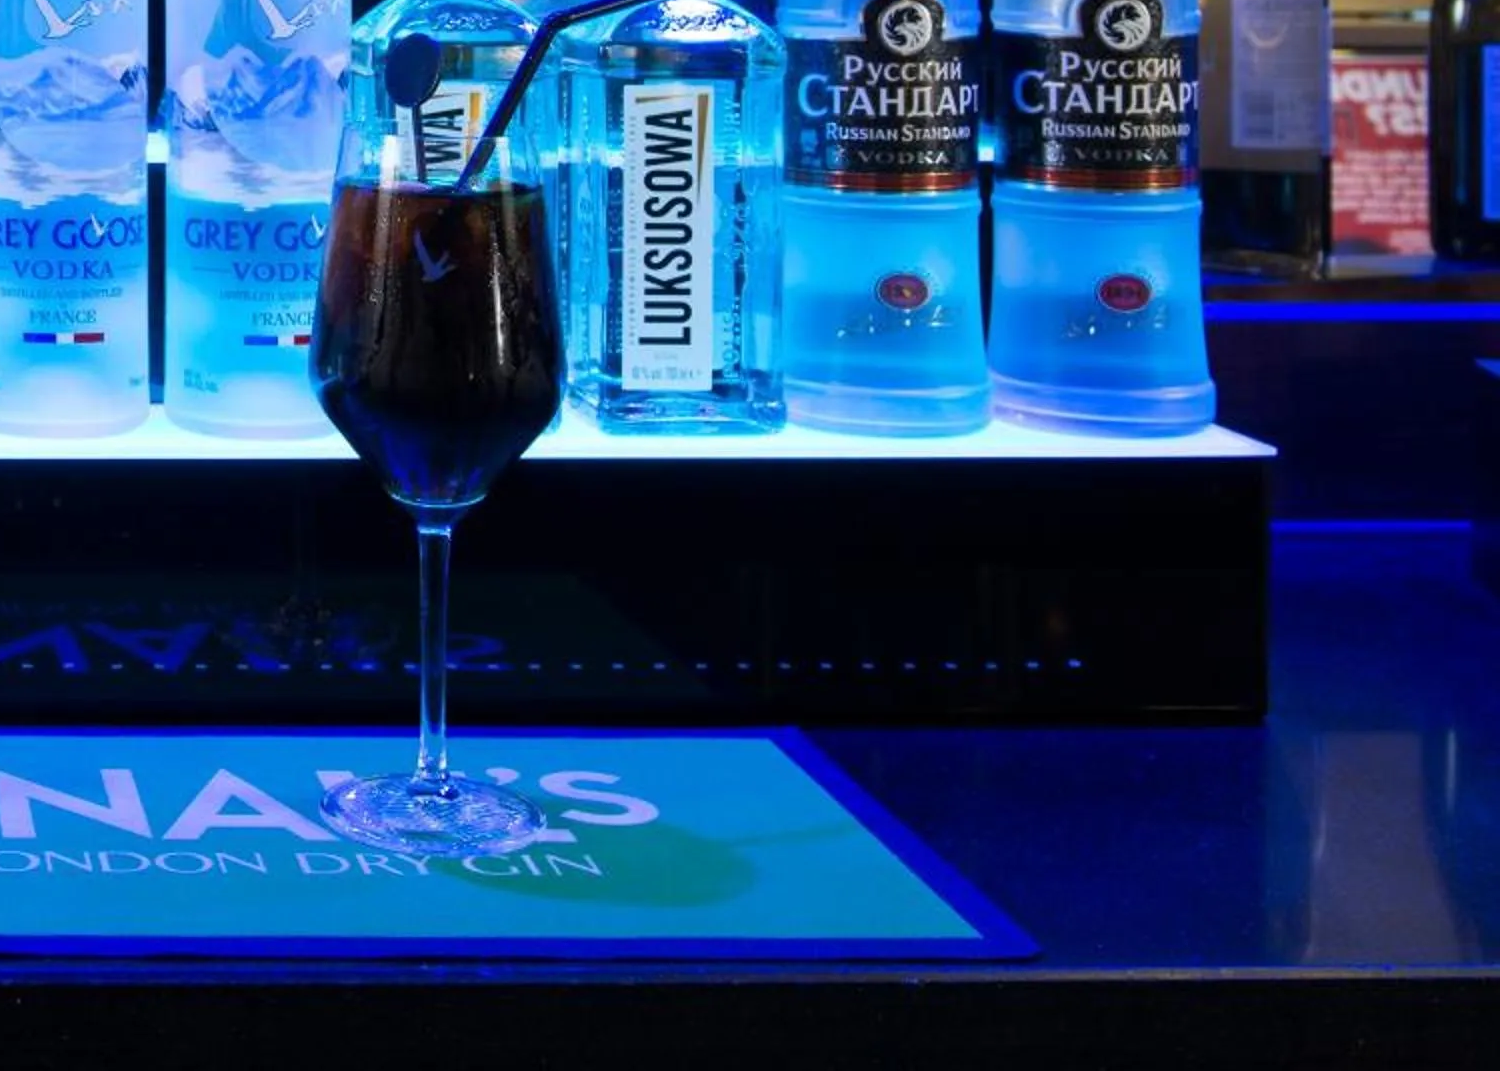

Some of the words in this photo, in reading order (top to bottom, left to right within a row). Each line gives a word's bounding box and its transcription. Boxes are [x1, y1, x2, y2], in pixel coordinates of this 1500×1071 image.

[51, 214, 145, 251] GOOSE
[184, 218, 264, 252] GREY
[638, 108, 694, 346] LUKSUSOWA
[11, 258, 115, 281] VODKA
[29, 308, 98, 325] FRANCE
[300, 849, 433, 877] DRY
[461, 851, 604, 878] GIN
